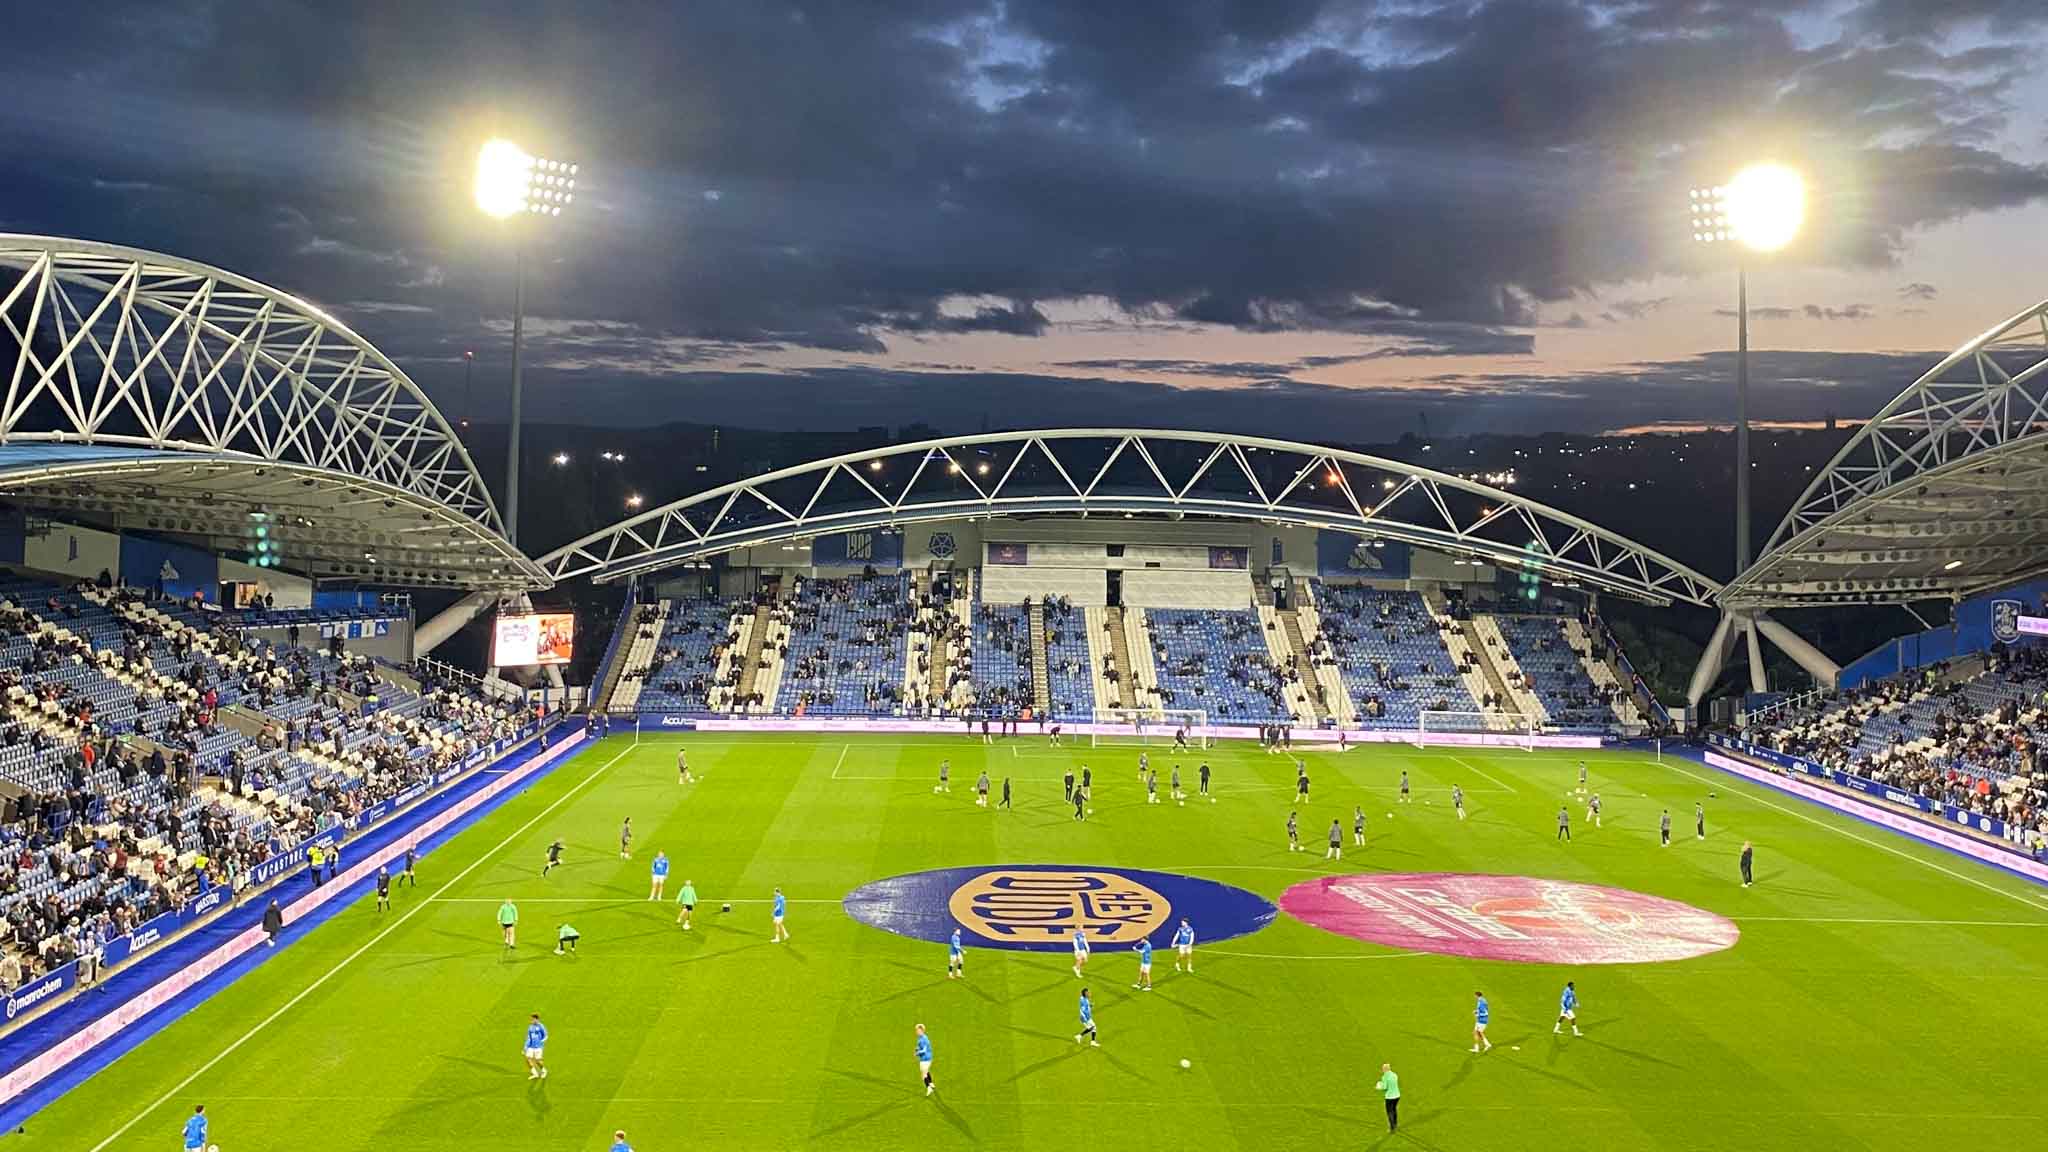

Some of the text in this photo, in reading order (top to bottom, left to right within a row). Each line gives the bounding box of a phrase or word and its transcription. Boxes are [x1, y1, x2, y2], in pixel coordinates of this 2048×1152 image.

[268, 848, 303, 876] CASTORE
[970, 876, 1123, 936] DUDE
[1082, 890, 1153, 923] HEY
[1383, 914, 1458, 939] DRINK
[16, 977, 62, 1010] manrochem
